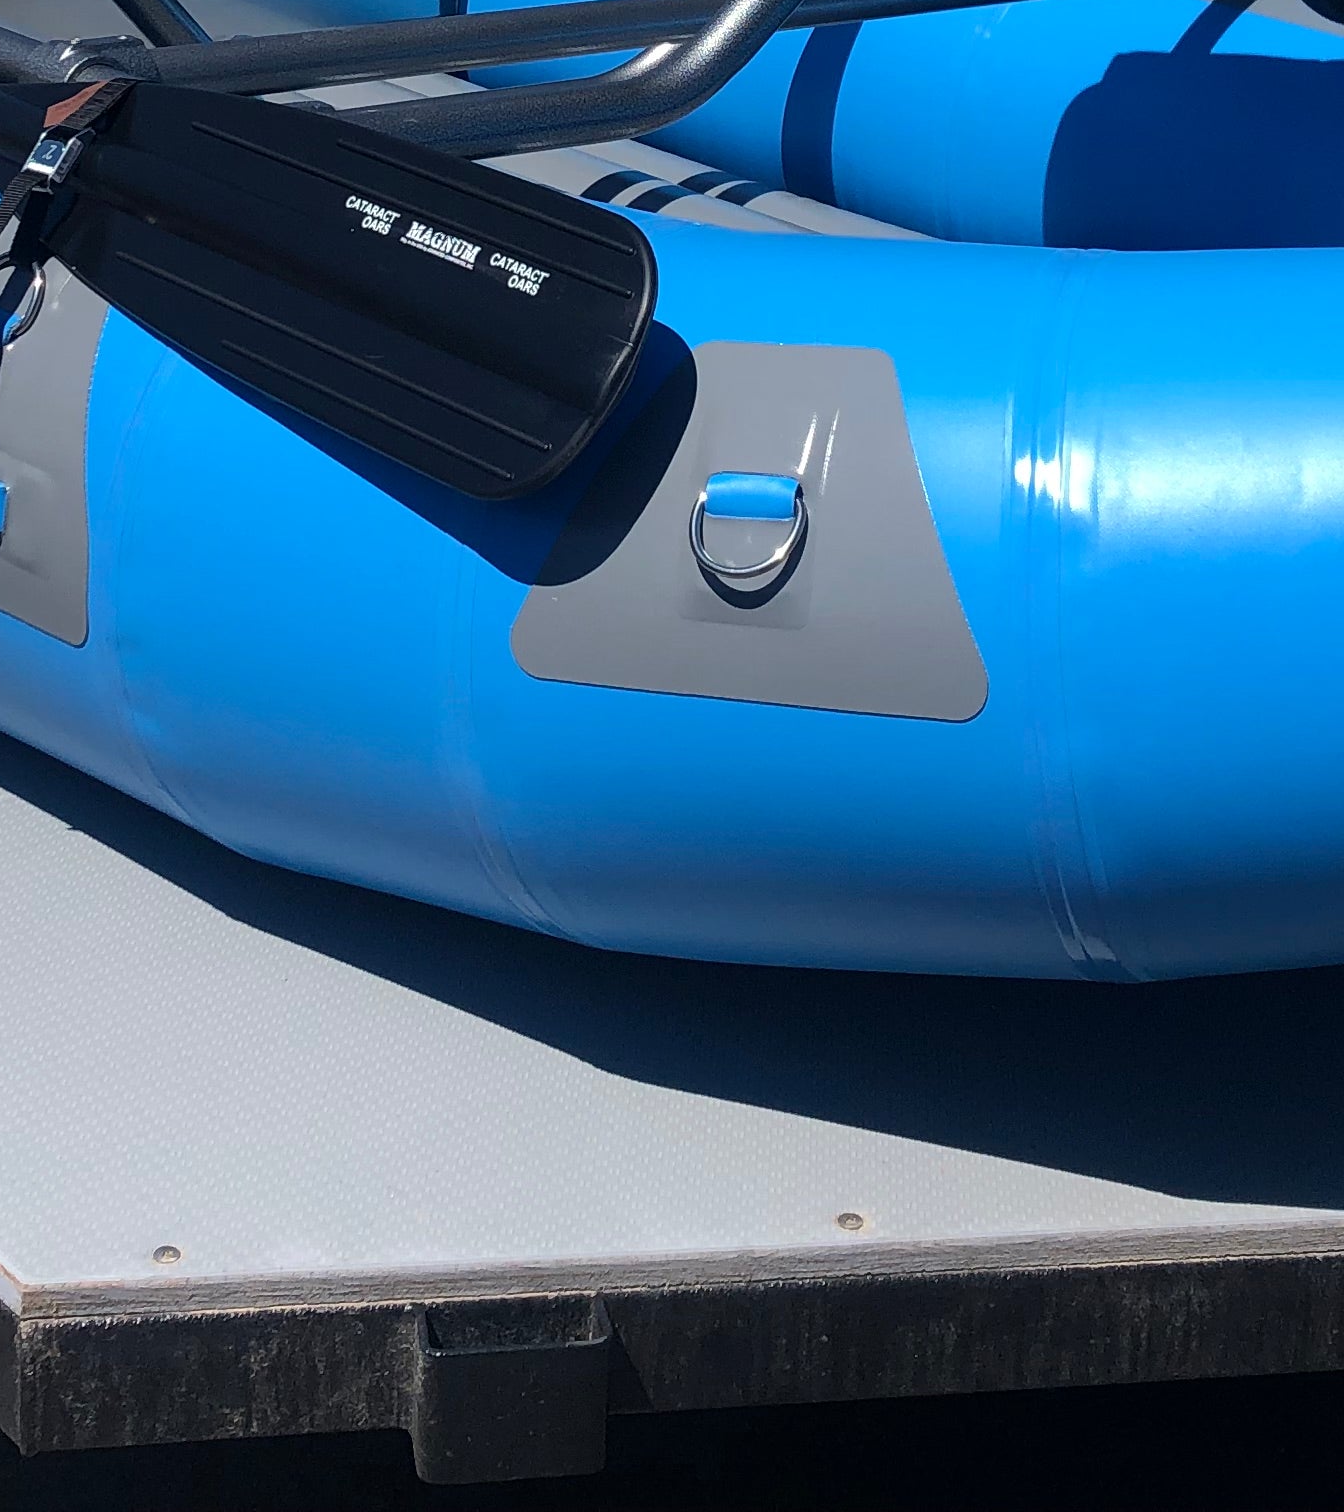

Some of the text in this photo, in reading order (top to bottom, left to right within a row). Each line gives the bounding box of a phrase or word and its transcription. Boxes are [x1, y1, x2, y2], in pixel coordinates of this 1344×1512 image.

[345, 195, 401, 225] CATARACT
[361, 217, 392, 236] OARS
[405, 220, 482, 264] MAGNUM
[489, 252, 550, 285] CATARACT
[507, 274, 540, 296] OARS
